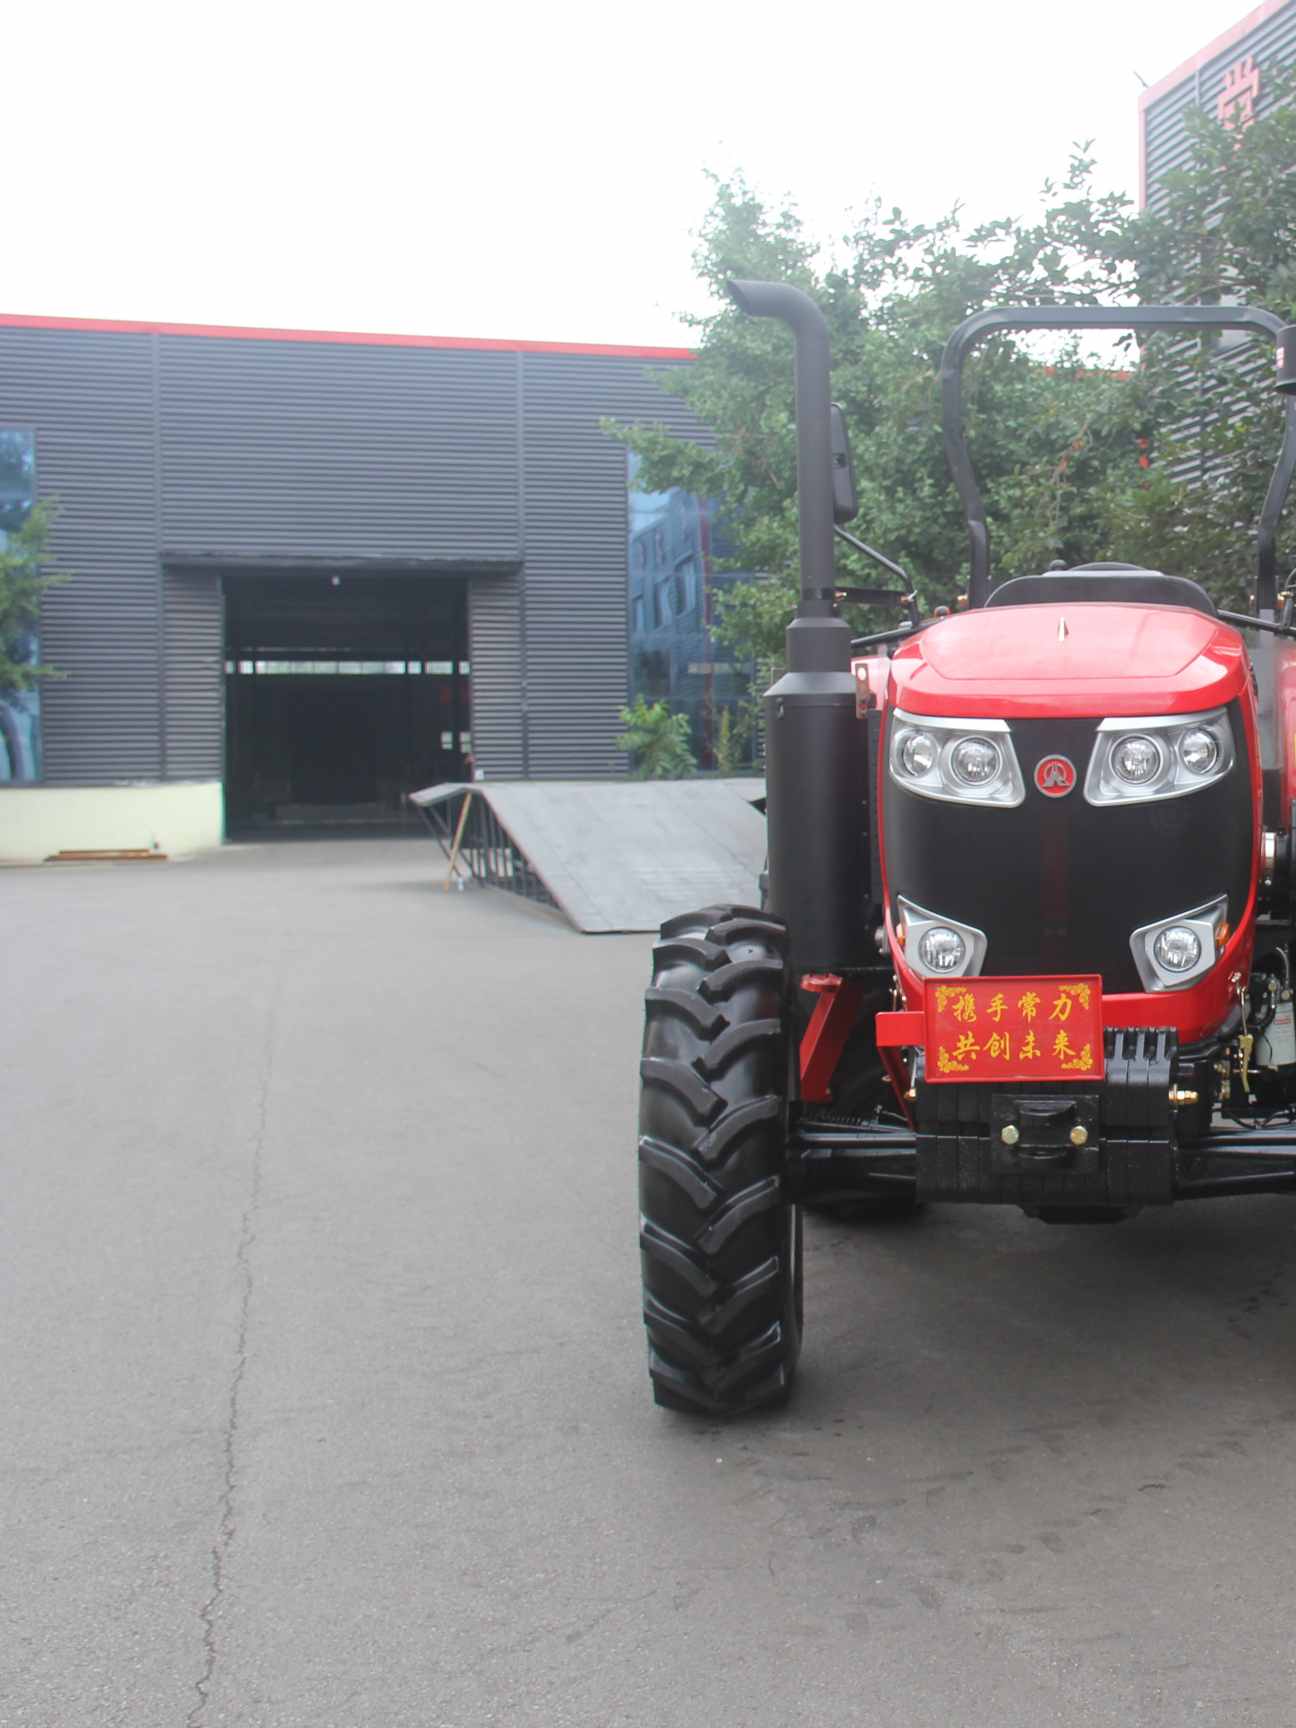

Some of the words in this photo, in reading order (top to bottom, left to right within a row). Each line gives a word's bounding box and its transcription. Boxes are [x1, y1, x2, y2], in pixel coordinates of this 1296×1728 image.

[952, 991, 1073, 1023] 携手常力
[952, 1029, 1077, 1061] 共创未来
